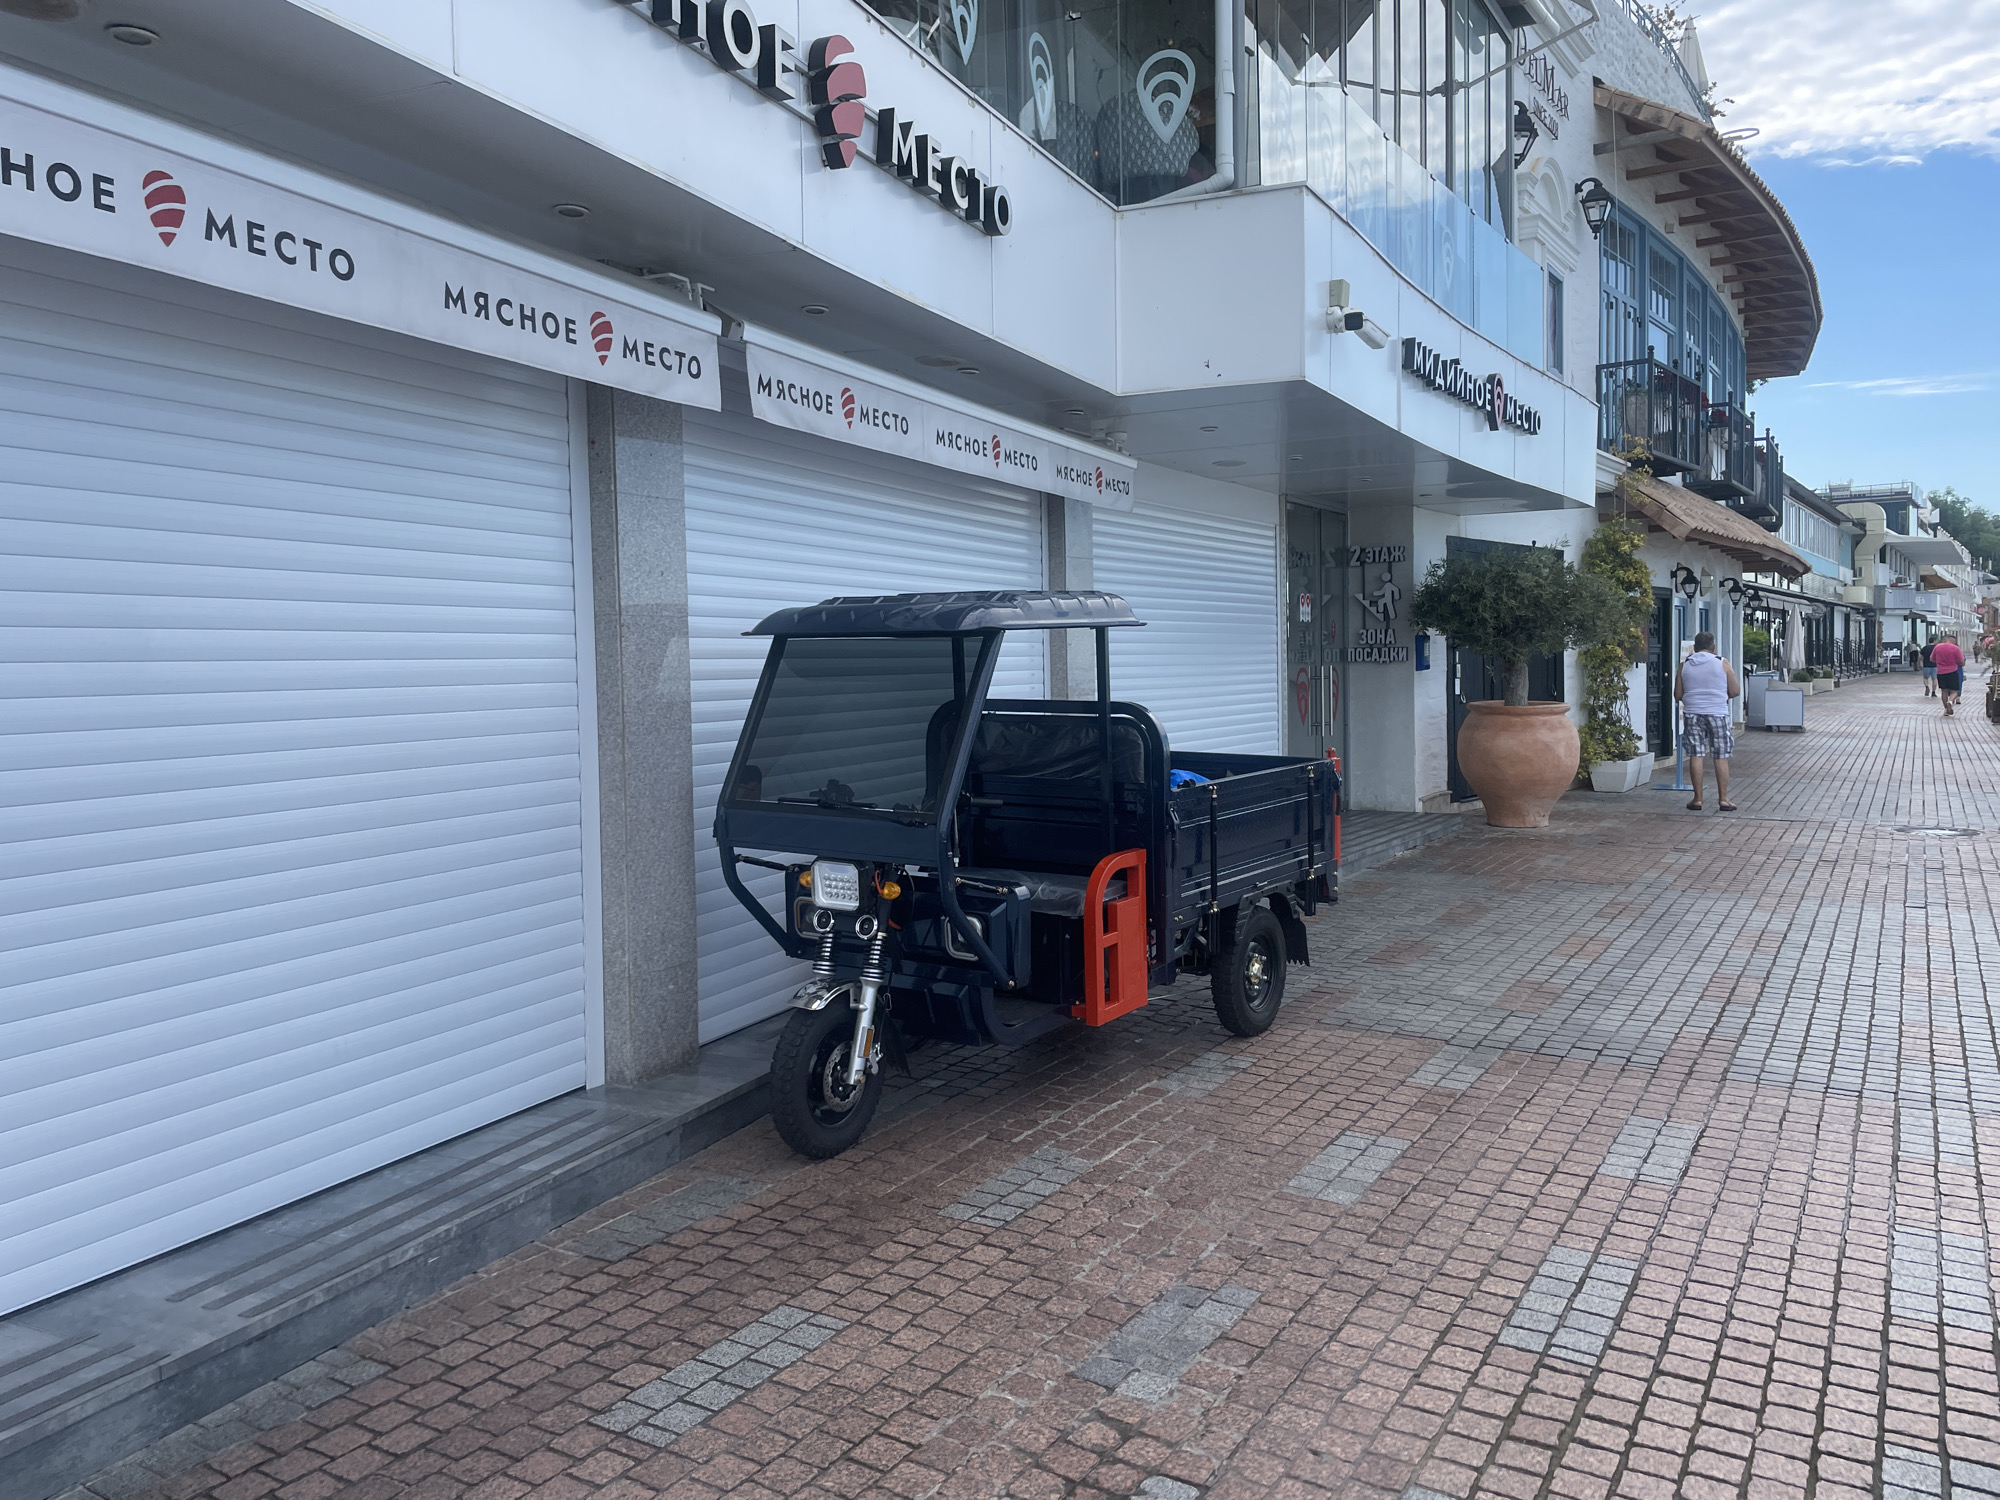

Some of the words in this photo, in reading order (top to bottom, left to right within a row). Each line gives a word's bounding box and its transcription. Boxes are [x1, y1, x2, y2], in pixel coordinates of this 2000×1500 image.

[877, 107, 1013, 236] МЕСТО
[0, 146, 116, 214] НОЕ
[204, 207, 356, 281] МЕСТО
[444, 281, 577, 345] МЯСНОЕ
[622, 335, 702, 380] МЕСТО
[756, 373, 834, 416] МЯСНОЕ
[859, 404, 909, 436] МЕСТО
[1403, 337, 1492, 412] МИДИЙНОЕ
[1503, 393, 1541, 435] МЕСТО
[935, 428, 988, 458] МЯСНОЕ
[1004, 449, 1038, 472] МЕСТО
[1056, 464, 1093, 486] МЯСНОЕ
[1105, 477, 1130, 496] МЕСТО
[1350, 546, 1361, 567] 2
[1365, 546, 1406, 564] ЭТАЖ
[1347, 647, 1408, 664] ПОСАДКИ
[1359, 629, 1396, 645] ЗОНА
